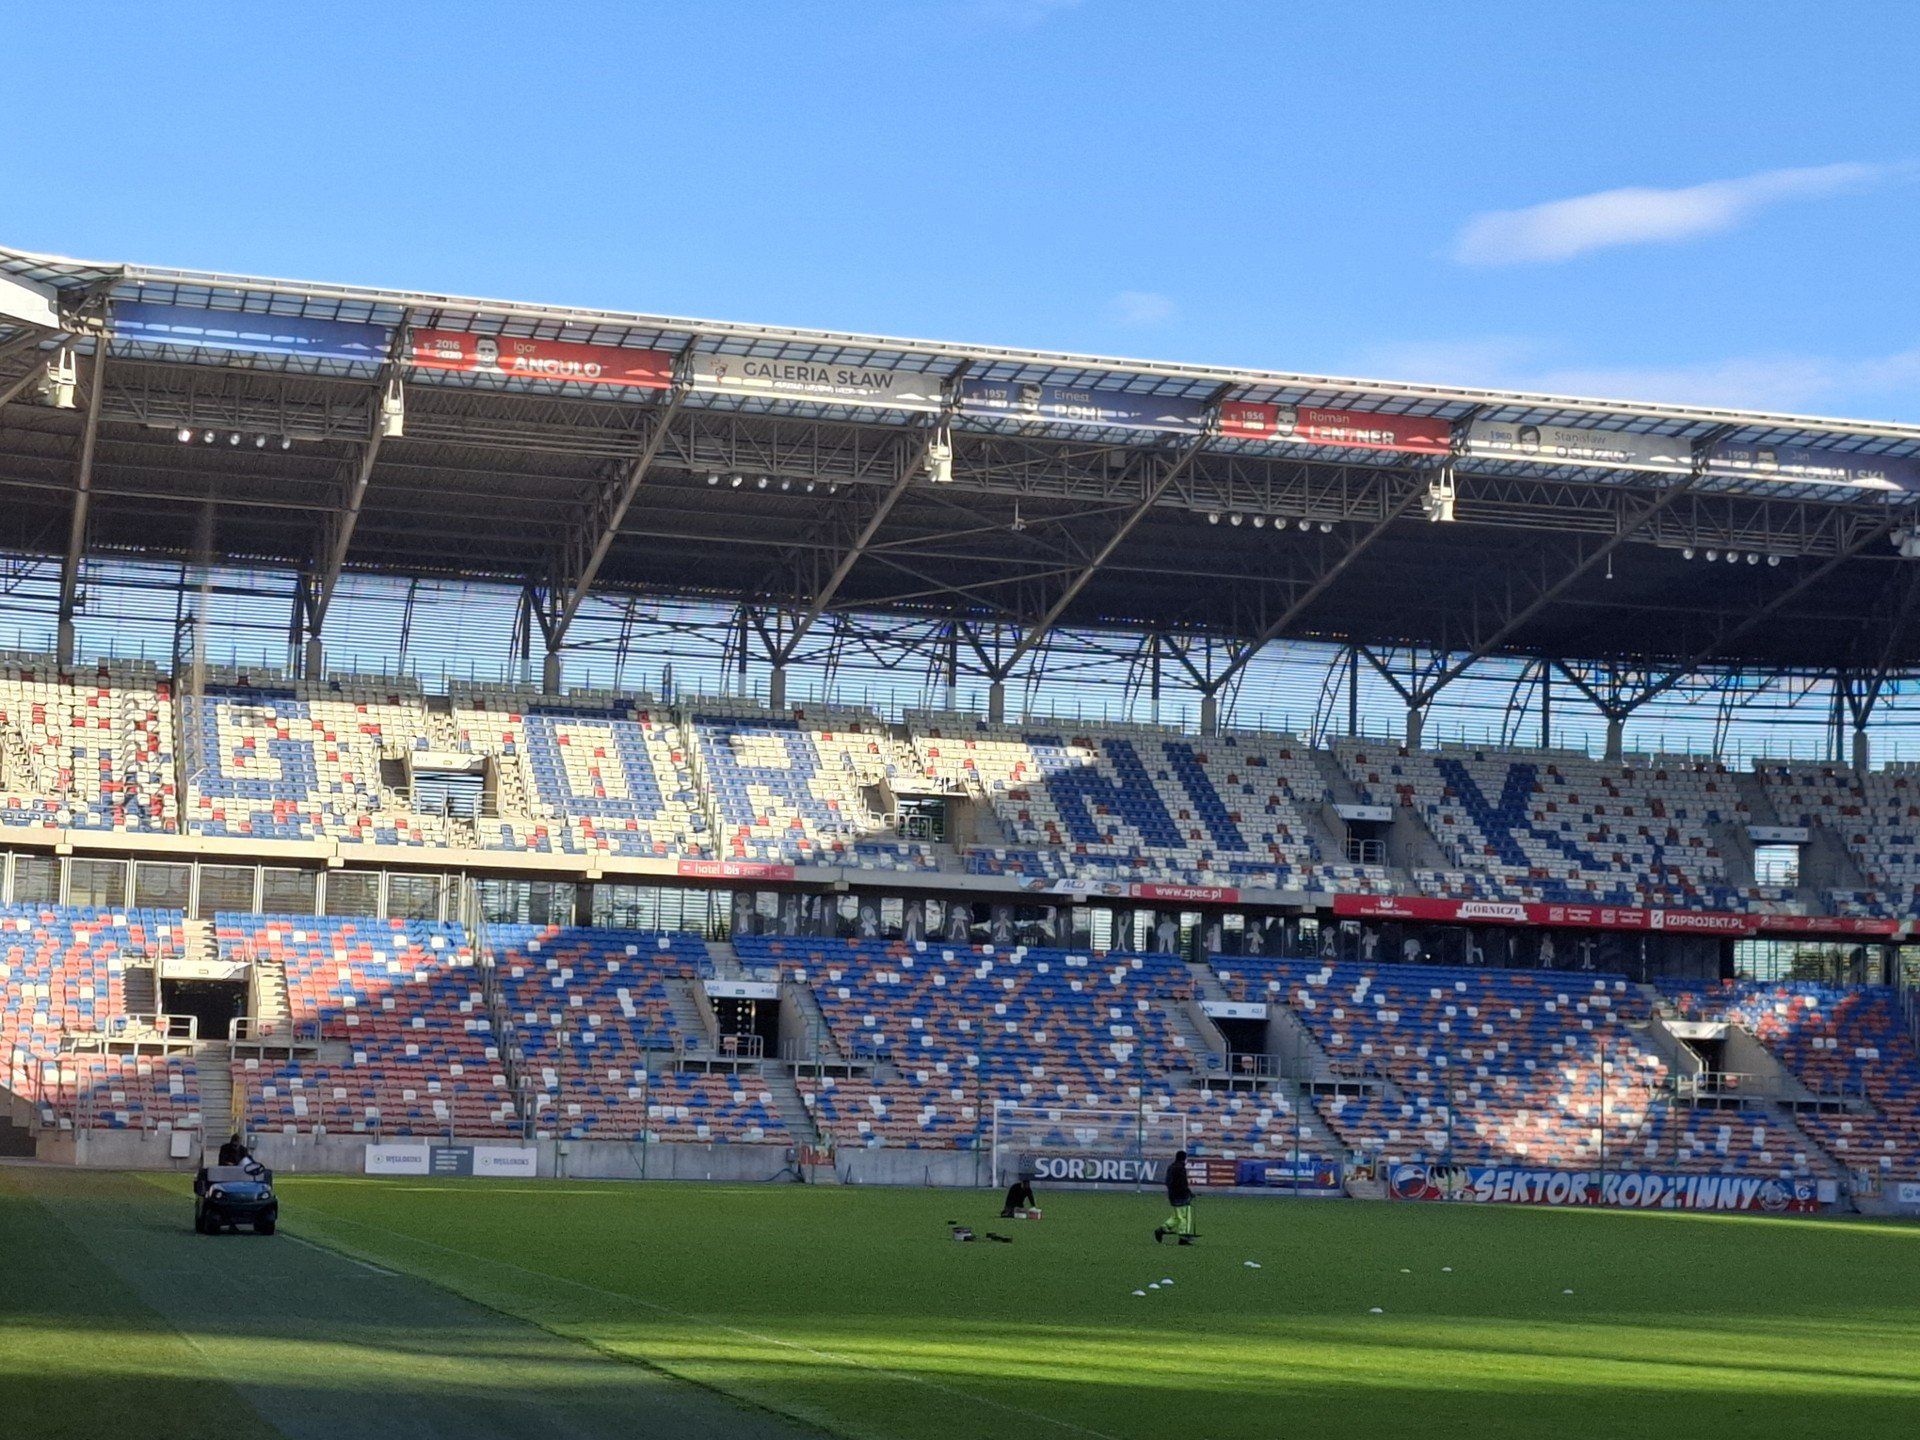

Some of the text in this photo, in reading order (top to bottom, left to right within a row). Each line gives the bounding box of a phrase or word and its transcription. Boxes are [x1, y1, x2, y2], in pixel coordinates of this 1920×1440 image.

[436, 339, 460, 350] 2016
[513, 341, 537, 354] Igor
[513, 357, 601, 378] ANGULO
[743, 361, 830, 383] GALERIA
[837, 370, 895, 389] SŁAW
[1054, 389, 1090, 402] Ernest
[1309, 410, 1350, 424] Roman
[1309, 425, 1395, 446] LENTNER
[695, 863, 720, 875] hotel
[723, 865, 740, 875] ibis
[1034, 1157, 1159, 1181] SORDREW
[1475, 1169, 1589, 1205] SEKTOR
